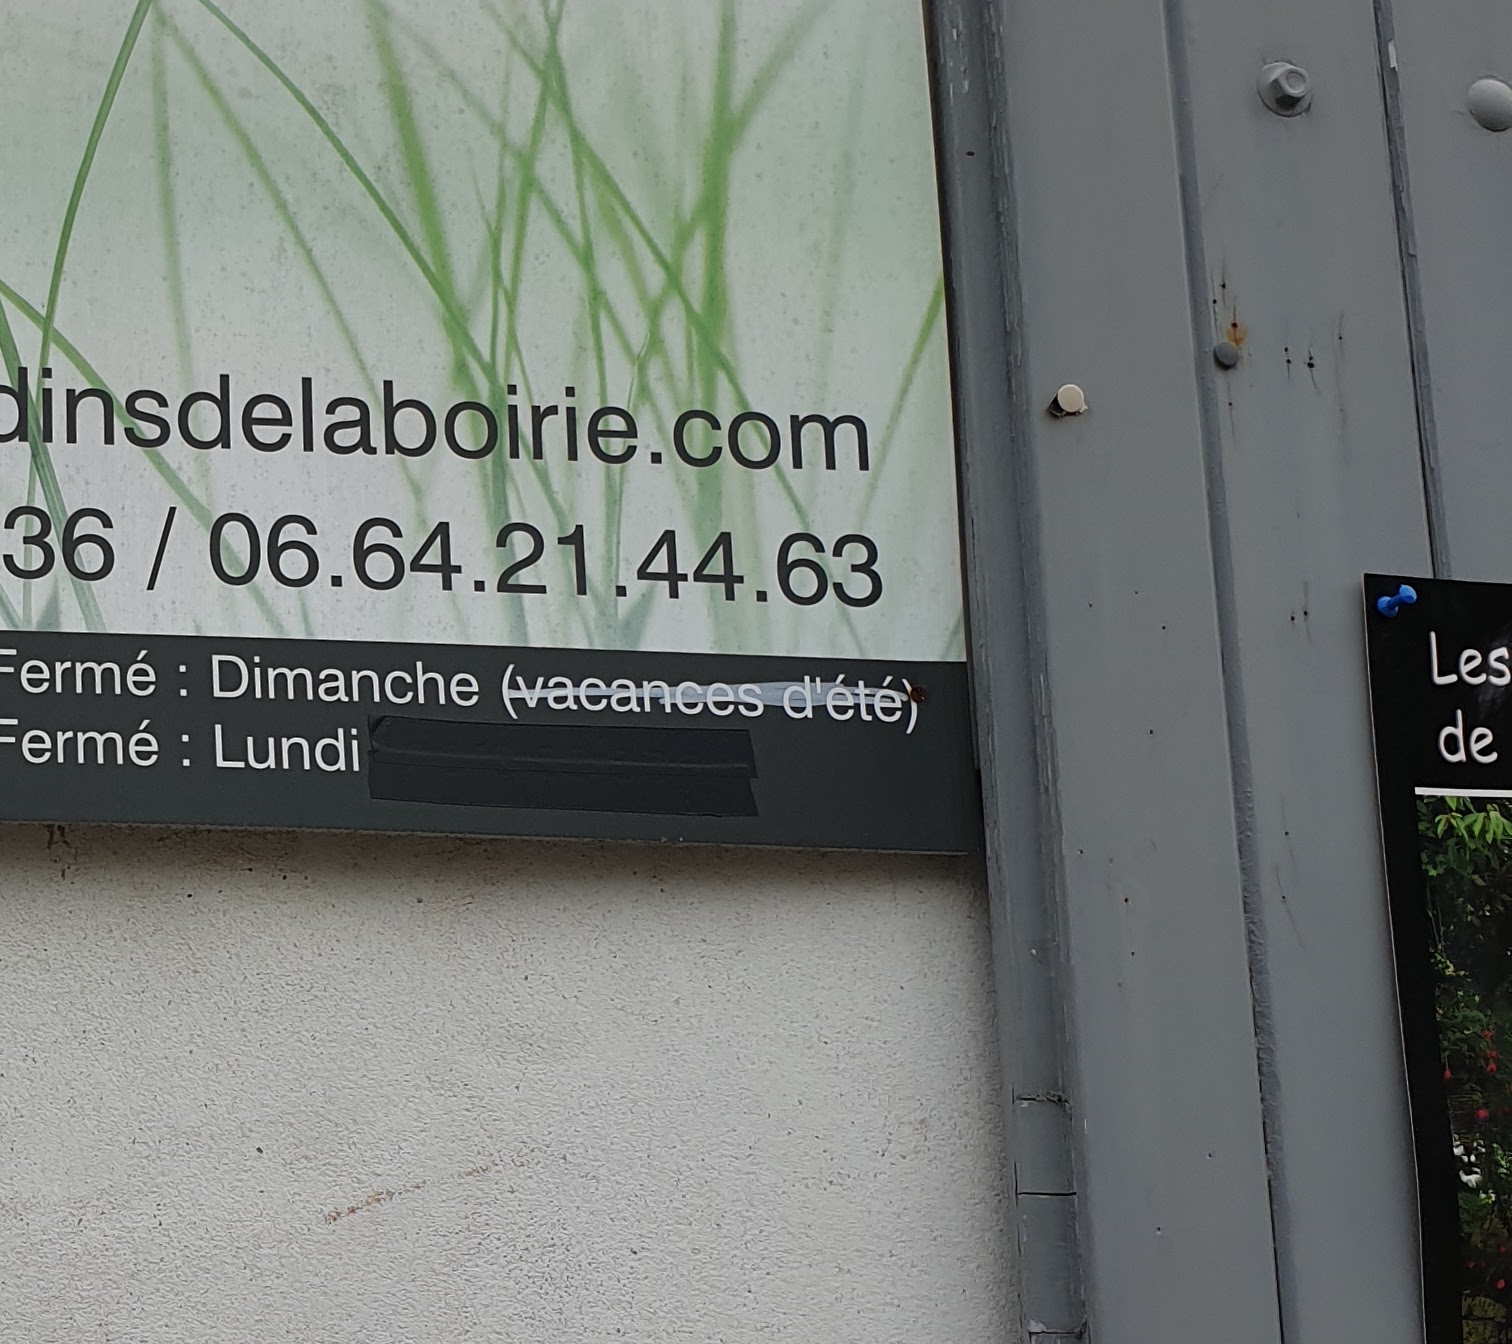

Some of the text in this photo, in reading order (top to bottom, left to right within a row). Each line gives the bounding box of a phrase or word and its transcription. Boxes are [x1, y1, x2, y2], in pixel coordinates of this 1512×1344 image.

[145, 506, 178, 591] /
[207, 511, 883, 608] 06.64.21.44.63
[1429, 630, 1511, 686] Les
[178, 663, 188, 698] :
[211, 654, 479, 706] Dimanche
[501, 662, 764, 720] (vacances
[782, 673, 919, 734] d'été)
[181, 734, 191, 768] :
[214, 723, 360, 774] Lundi
[1439, 708, 1498, 764] de
